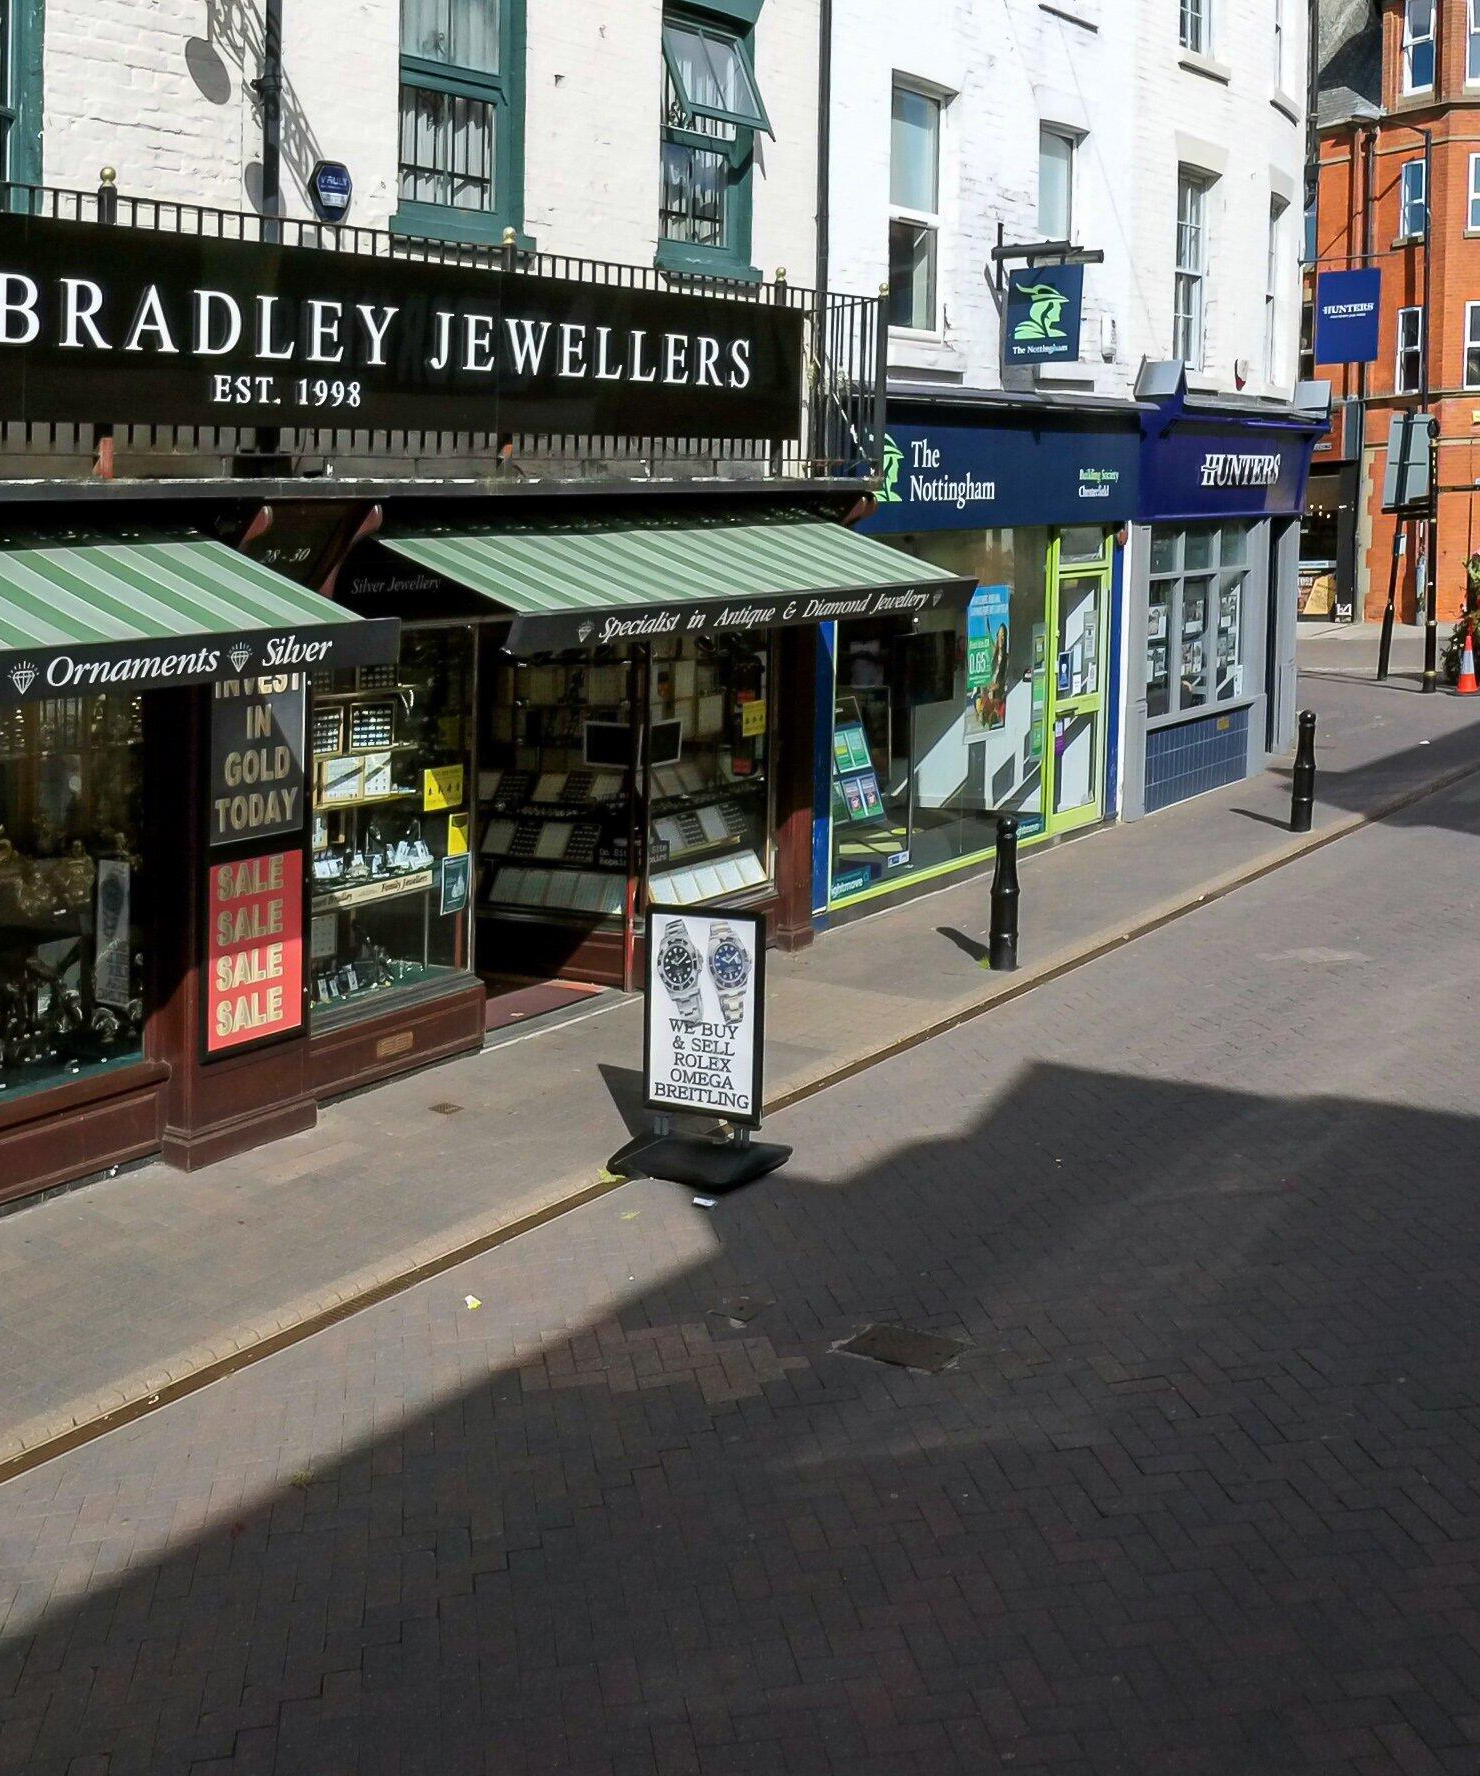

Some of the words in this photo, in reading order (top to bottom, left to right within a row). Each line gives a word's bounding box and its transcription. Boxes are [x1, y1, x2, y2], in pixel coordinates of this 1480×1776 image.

[1322, 302, 1374, 315] HUNTERS
[430, 309, 752, 390] JEWELLERS
[1012, 345, 1026, 355] The
[1027, 343, 1069, 355] Nottingham
[212, 375, 281, 406] EST.
[295, 380, 362, 409] 1998
[911, 438, 941, 468] The
[1200, 453, 1281, 486] HUNTERS
[910, 472, 995, 509] Nottingham
[351, 577, 386, 595] Silver
[387, 574, 442, 593] Jewellery
[599, 615, 680, 644] Specialist
[687, 609, 706, 629] in
[714, 602, 775, 630] Antique
[782, 600, 797, 620] &
[802, 590, 868, 619] Diamond
[870, 588, 931, 615] Jewellery
[47, 646, 219, 688] Ornaments
[261, 635, 333, 668] Silver
[246, 703, 271, 740] IN
[224, 745, 290, 788] GOLD
[214, 786, 299, 834] TODAY
[217, 854, 285, 902] SALE
[832, 877, 863, 899] ightmove
[216, 898, 285, 947] SALE
[216, 942, 284, 993] SALE
[216, 986, 284, 1037] SALE
[669, 1018, 695, 1034] WE
[701, 1022, 739, 1040] BUY
[672, 1035, 685, 1050] &
[691, 1038, 736, 1056] SELL
[670, 1068, 735, 1090] OMEGA
[674, 1052, 732, 1073] ROLEX
[654, 1082, 749, 1109] BREITLING
